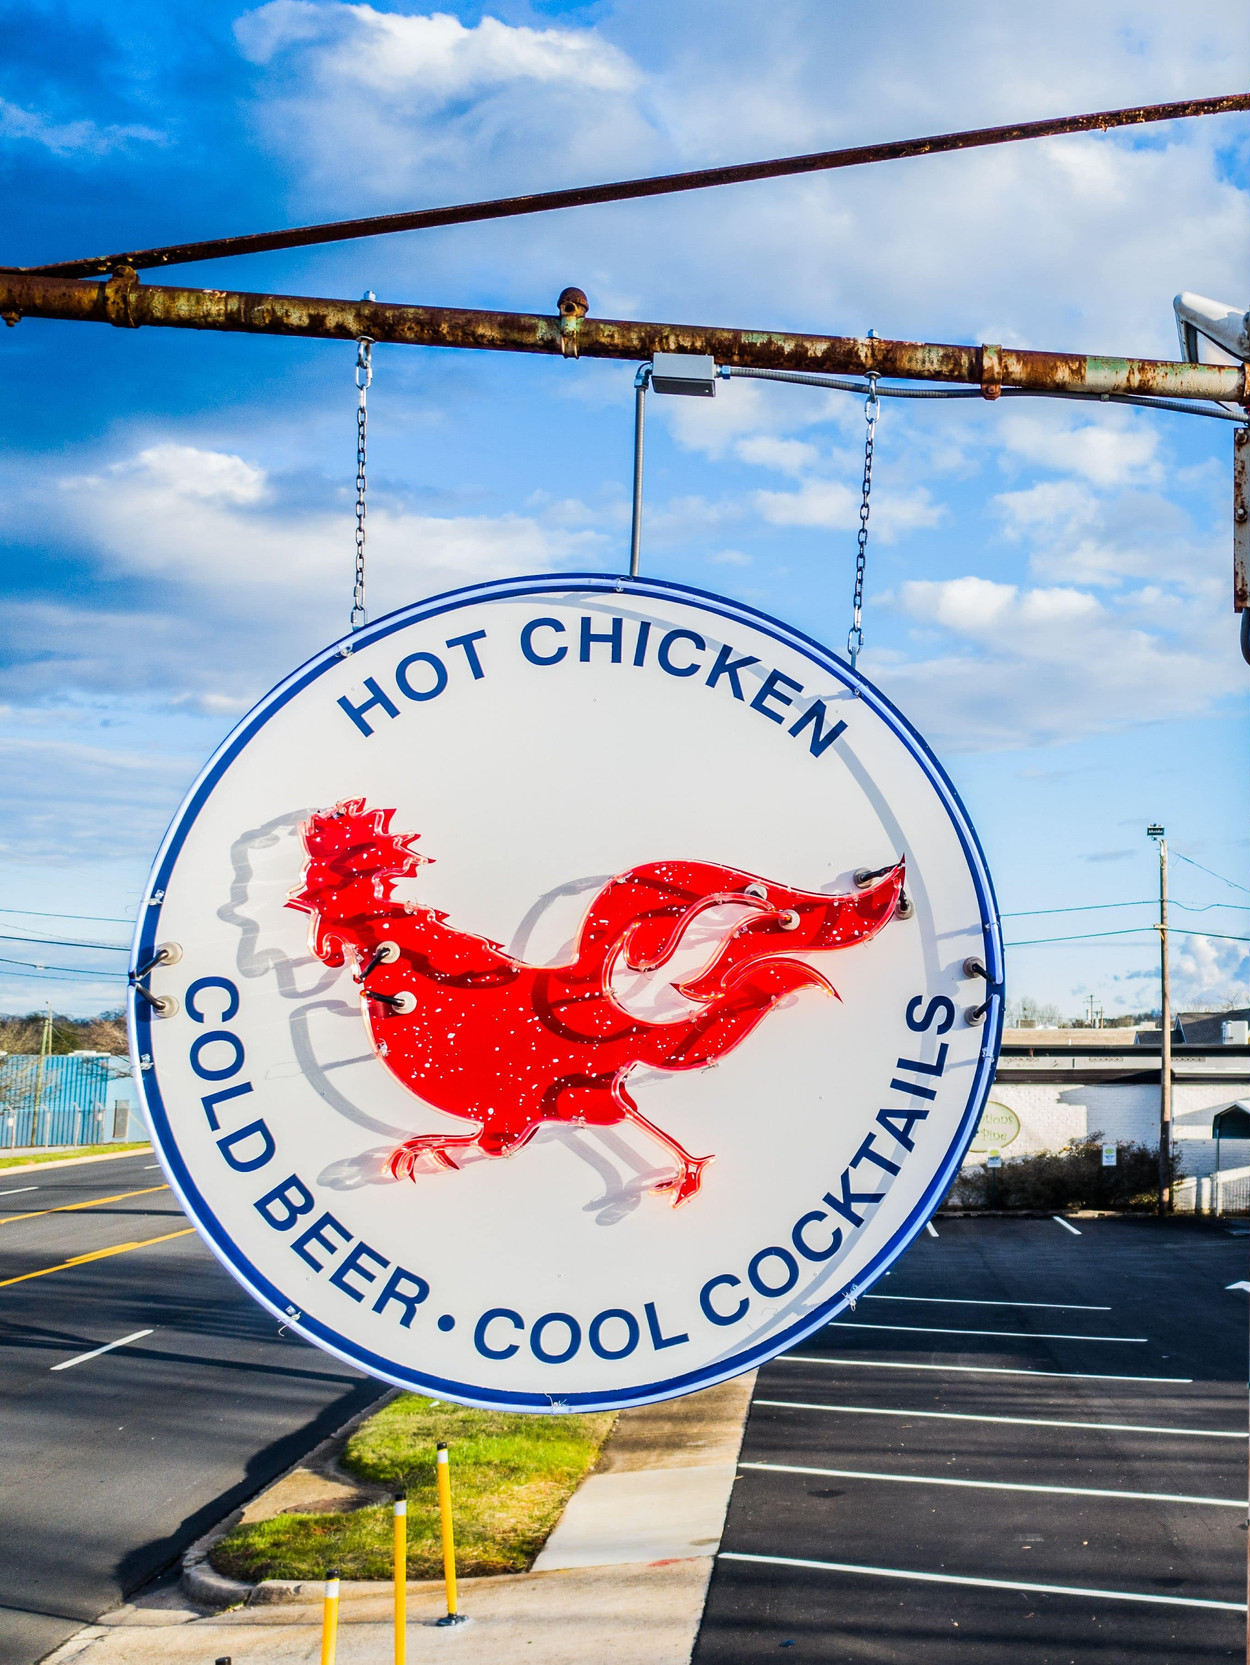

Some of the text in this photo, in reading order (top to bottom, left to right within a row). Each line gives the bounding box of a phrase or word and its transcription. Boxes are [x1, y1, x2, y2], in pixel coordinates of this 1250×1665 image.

[336, 616, 849, 758] HOT CHICKEN
[184, 975, 956, 1365] COLD BEER COOL COCKTAILS
